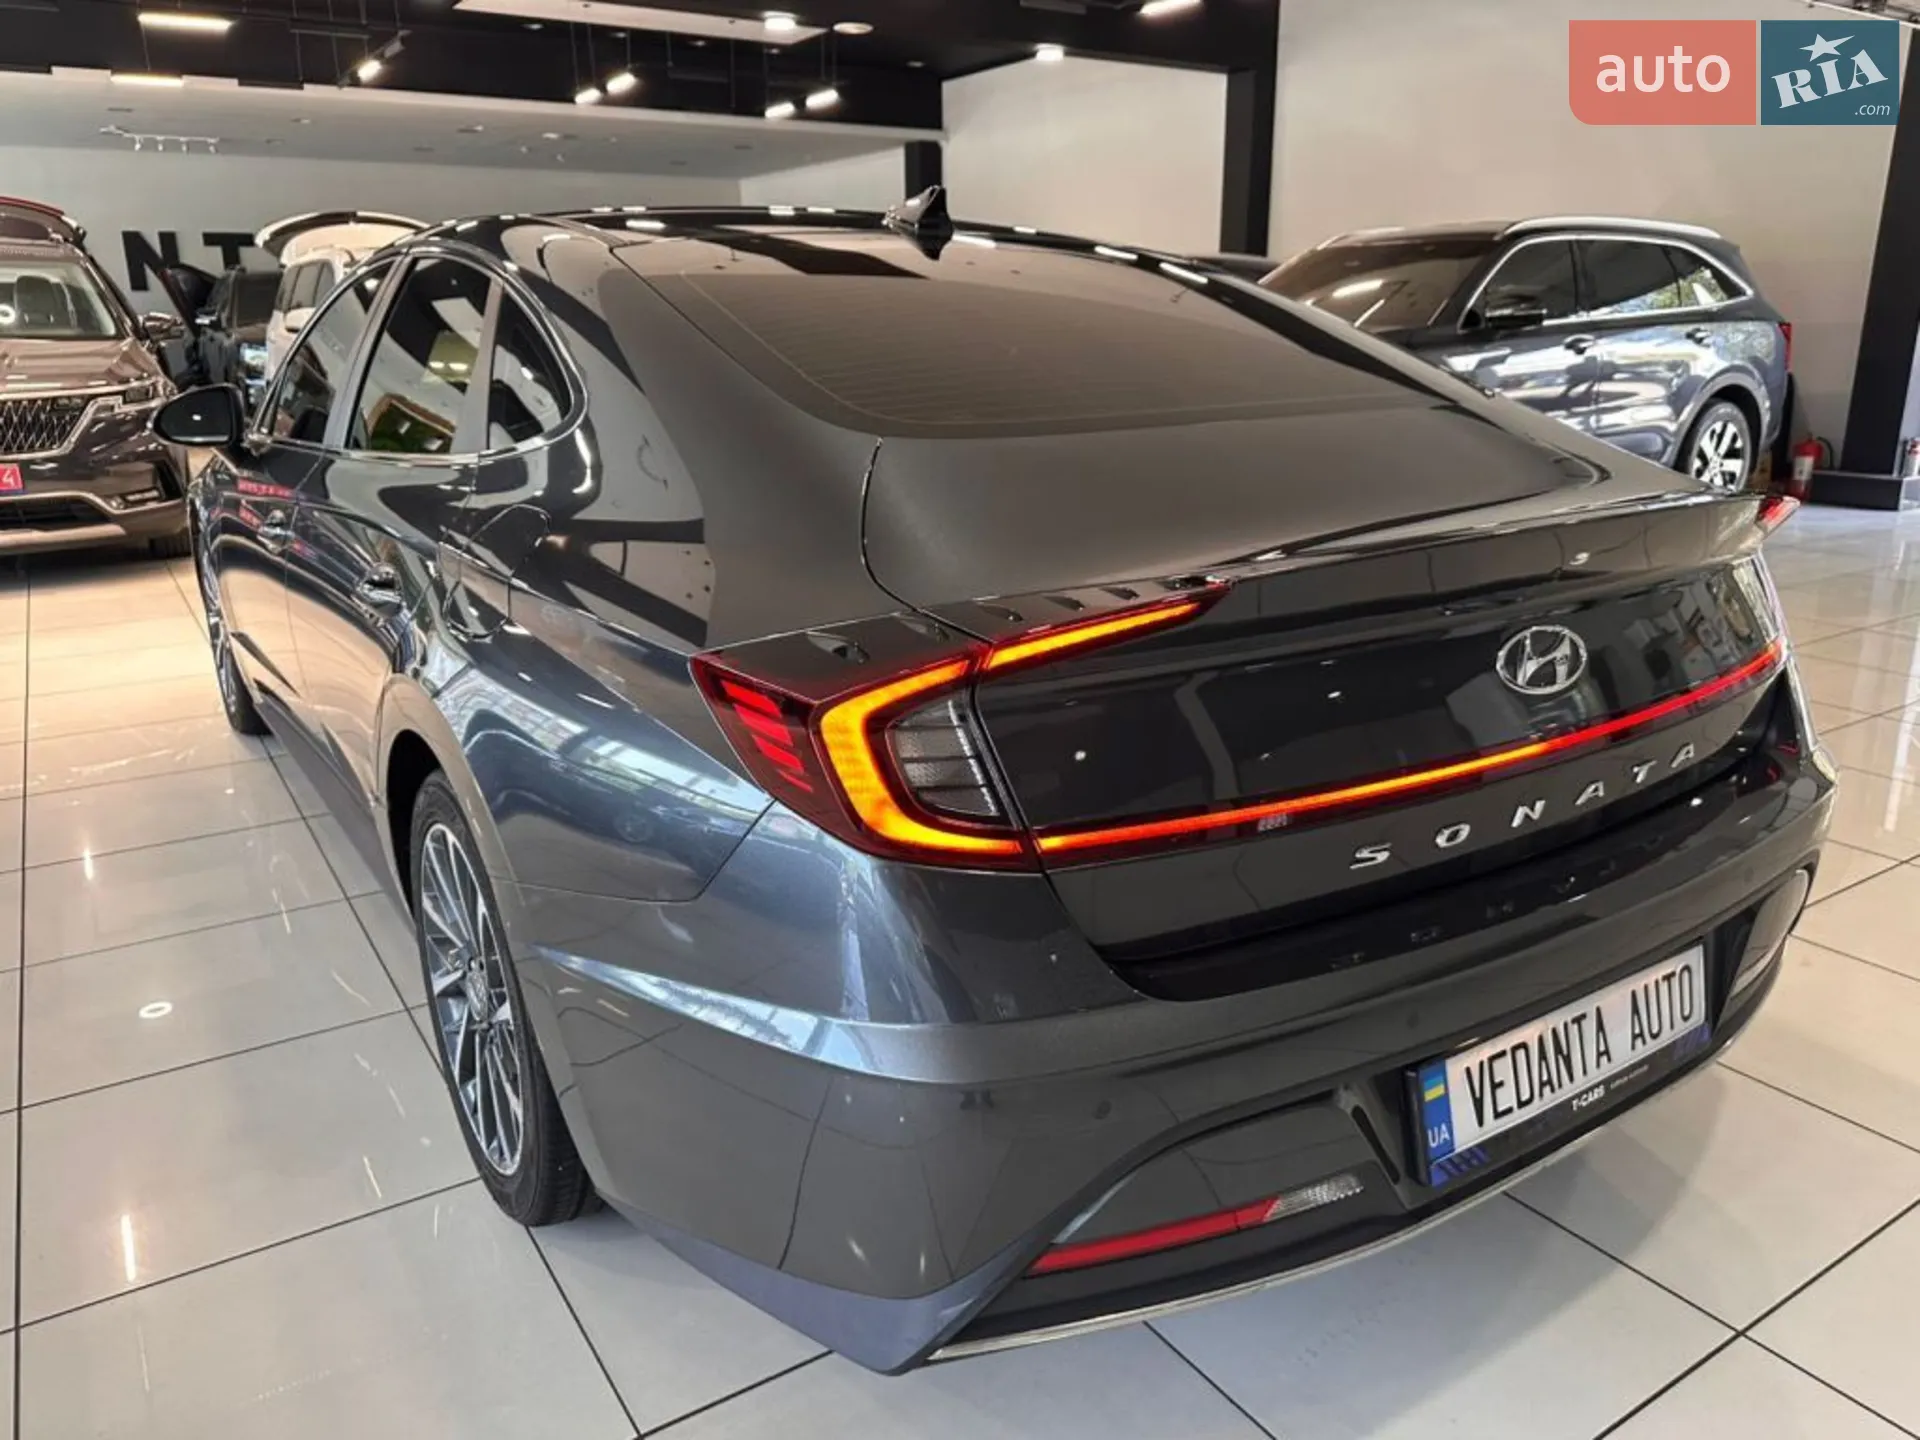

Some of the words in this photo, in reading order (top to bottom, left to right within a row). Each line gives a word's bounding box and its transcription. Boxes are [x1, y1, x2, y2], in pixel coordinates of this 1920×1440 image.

[1350, 743, 1696, 870] SONATA
[1464, 1005, 1612, 1128] VEDANTA
[1630, 963, 1694, 1051] AUTO
[1427, 1122, 1451, 1148] UA
